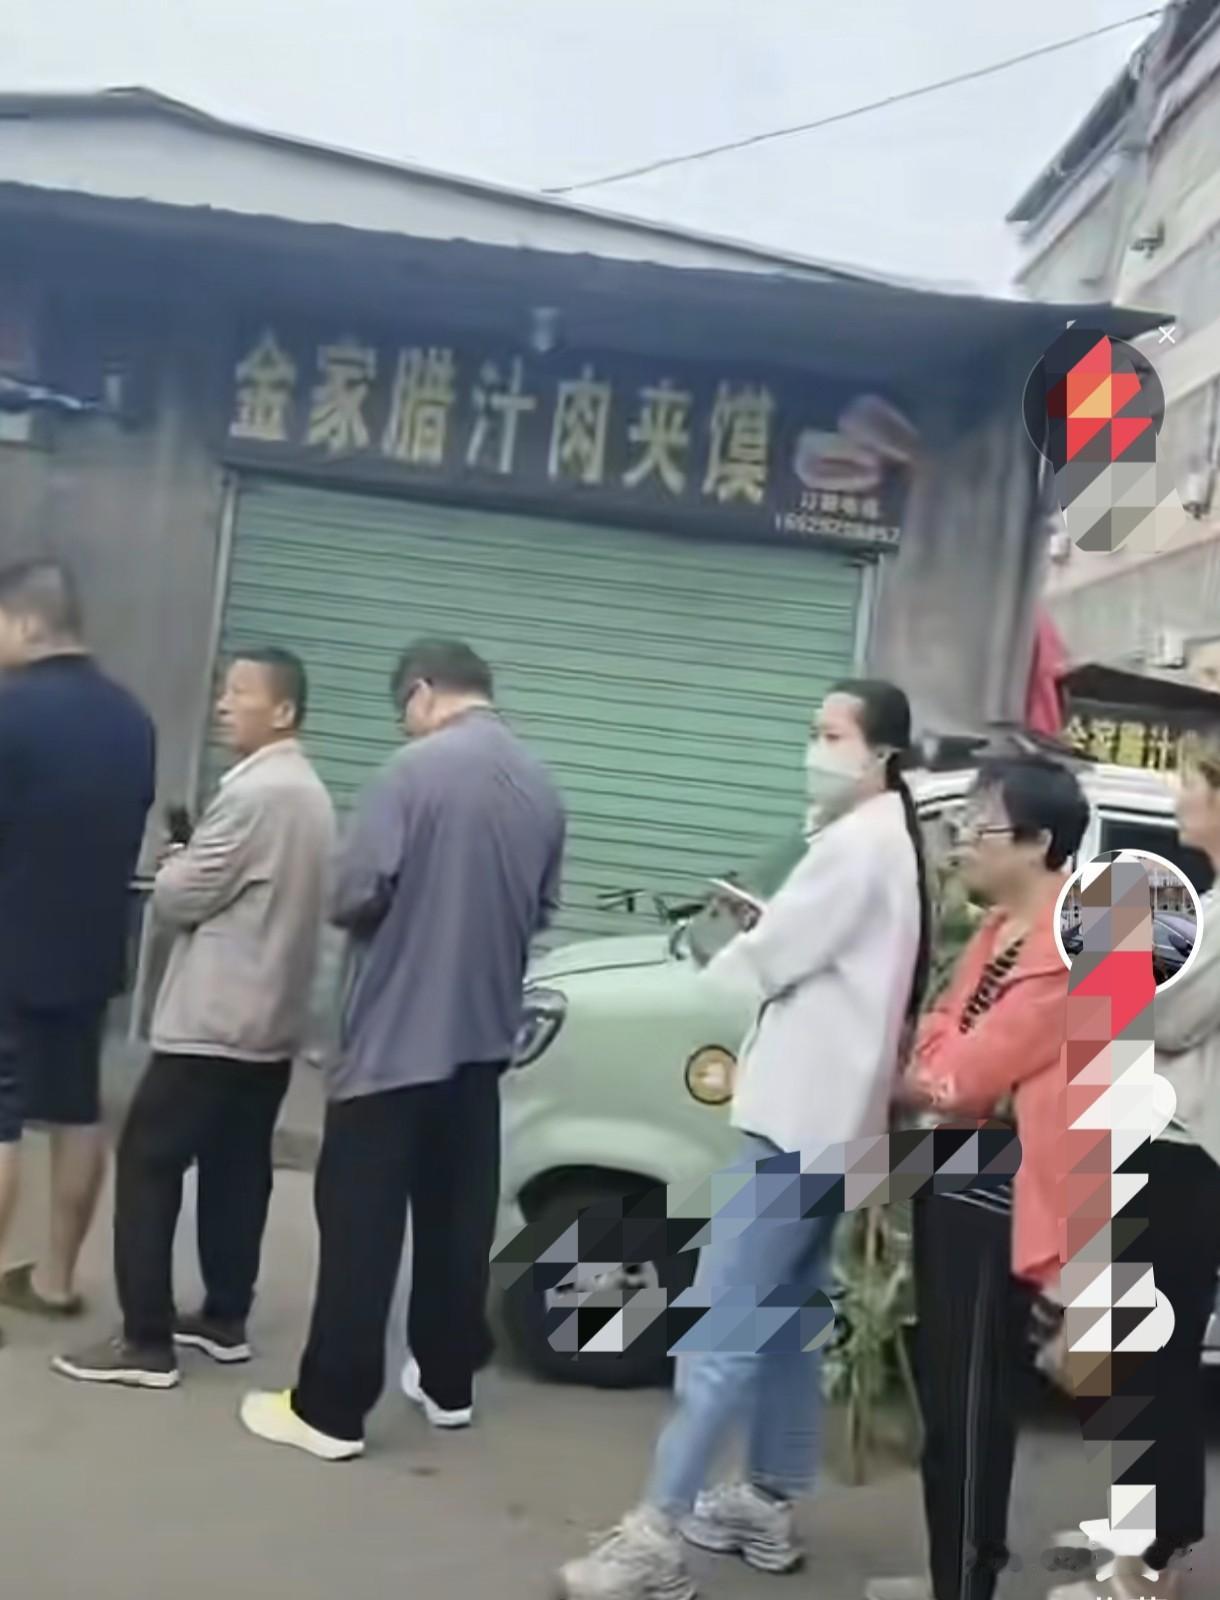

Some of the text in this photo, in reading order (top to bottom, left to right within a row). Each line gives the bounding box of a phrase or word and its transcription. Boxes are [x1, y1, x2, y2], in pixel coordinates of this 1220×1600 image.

[229, 331, 775, 503] 金家腊汁肉夹馍
